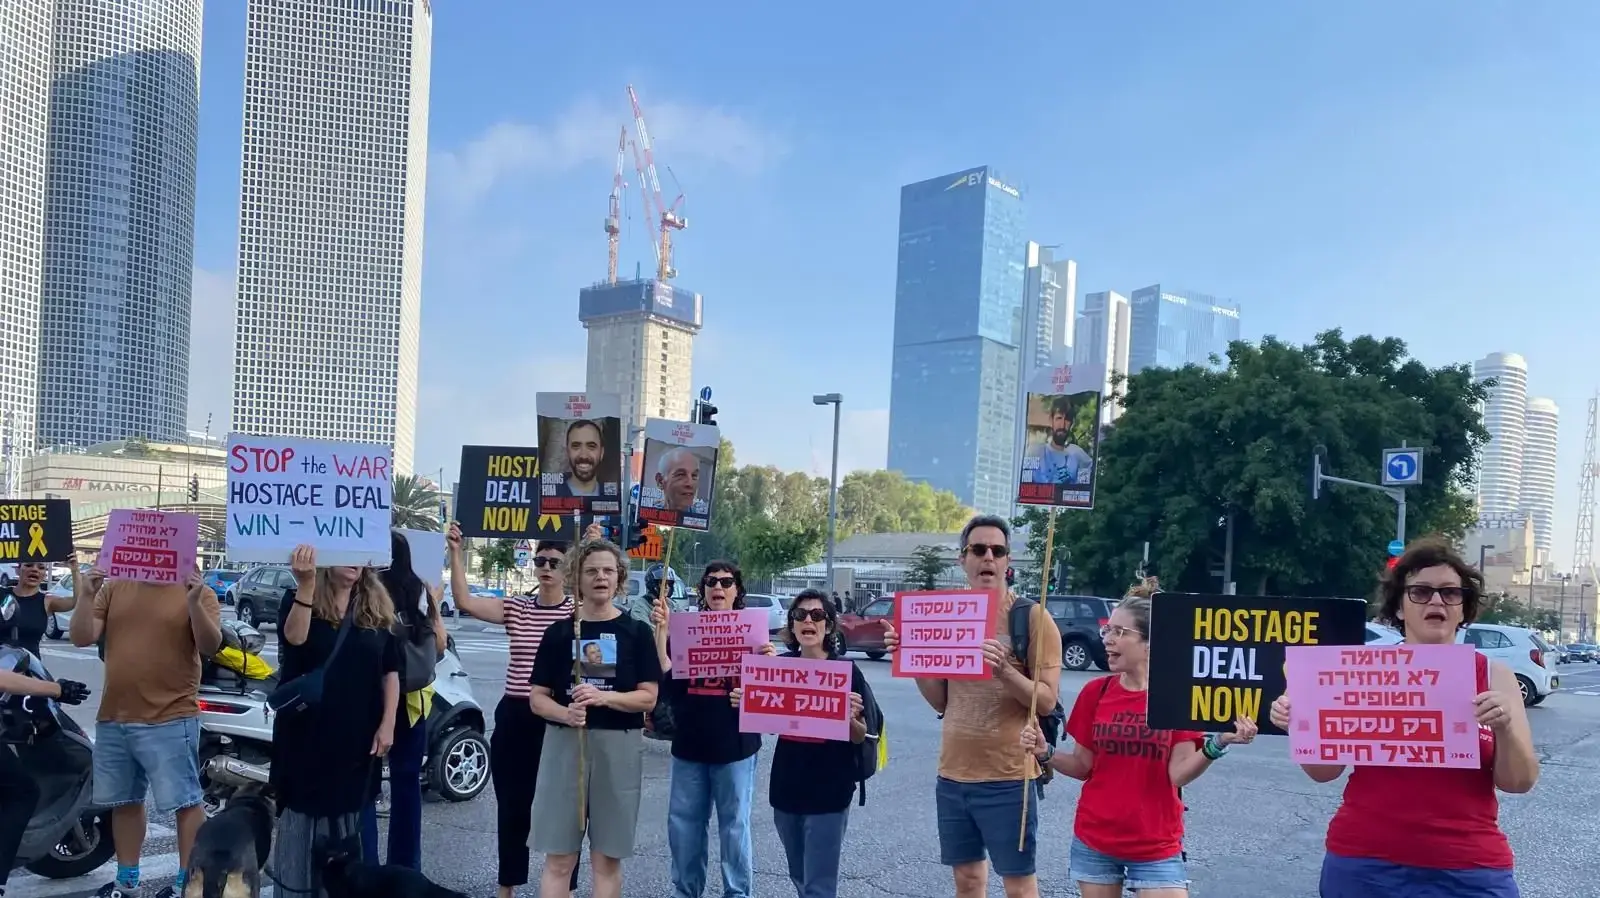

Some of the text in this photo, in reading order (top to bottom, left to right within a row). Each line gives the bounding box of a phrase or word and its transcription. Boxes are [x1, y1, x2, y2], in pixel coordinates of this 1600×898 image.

[968, 170, 984, 186] EY
[230, 445, 388, 480] STOP the WAR
[88, 482, 152, 492] MANGO
[485, 480, 531, 504] DEAL
[230, 481, 389, 509] HOSTAGE DEAL
[130, 512, 164, 522] לחימה
[482, 506, 530, 532] NOW
[118, 524, 178, 536] לא מחזירה
[233, 513, 280, 536] WIN
[314, 516, 364, 538] WIN
[122, 536, 168, 548] חטופים-
[116, 550, 174, 564] רק עסקה
[110, 566, 177, 581] תציל חיים
[911, 602, 978, 616] רק עסקה!
[700, 612, 738, 623] לחימה
[688, 624, 752, 635] לא מחזירה
[1194, 608, 1320, 644] HOSTAGE
[696, 636, 744, 646] חטופים-
[911, 628, 976, 642] רק עסקה!
[691, 651, 728, 662] עסקה
[911, 654, 974, 668] רק עסקה!
[1192, 646, 1264, 680] DEAL
[1341, 648, 1414, 665] לחימה
[689, 666, 717, 676] חיים
[1318, 668, 1440, 686] לא מחזירה
[814, 670, 848, 689] קול
[749, 690, 840, 713] זועק אלי
[1191, 686, 1262, 722] NOW
[1334, 692, 1426, 706] חטופים-
[1325, 716, 1437, 736] רק עסקה
[1320, 743, 1445, 764] תציל חיים
